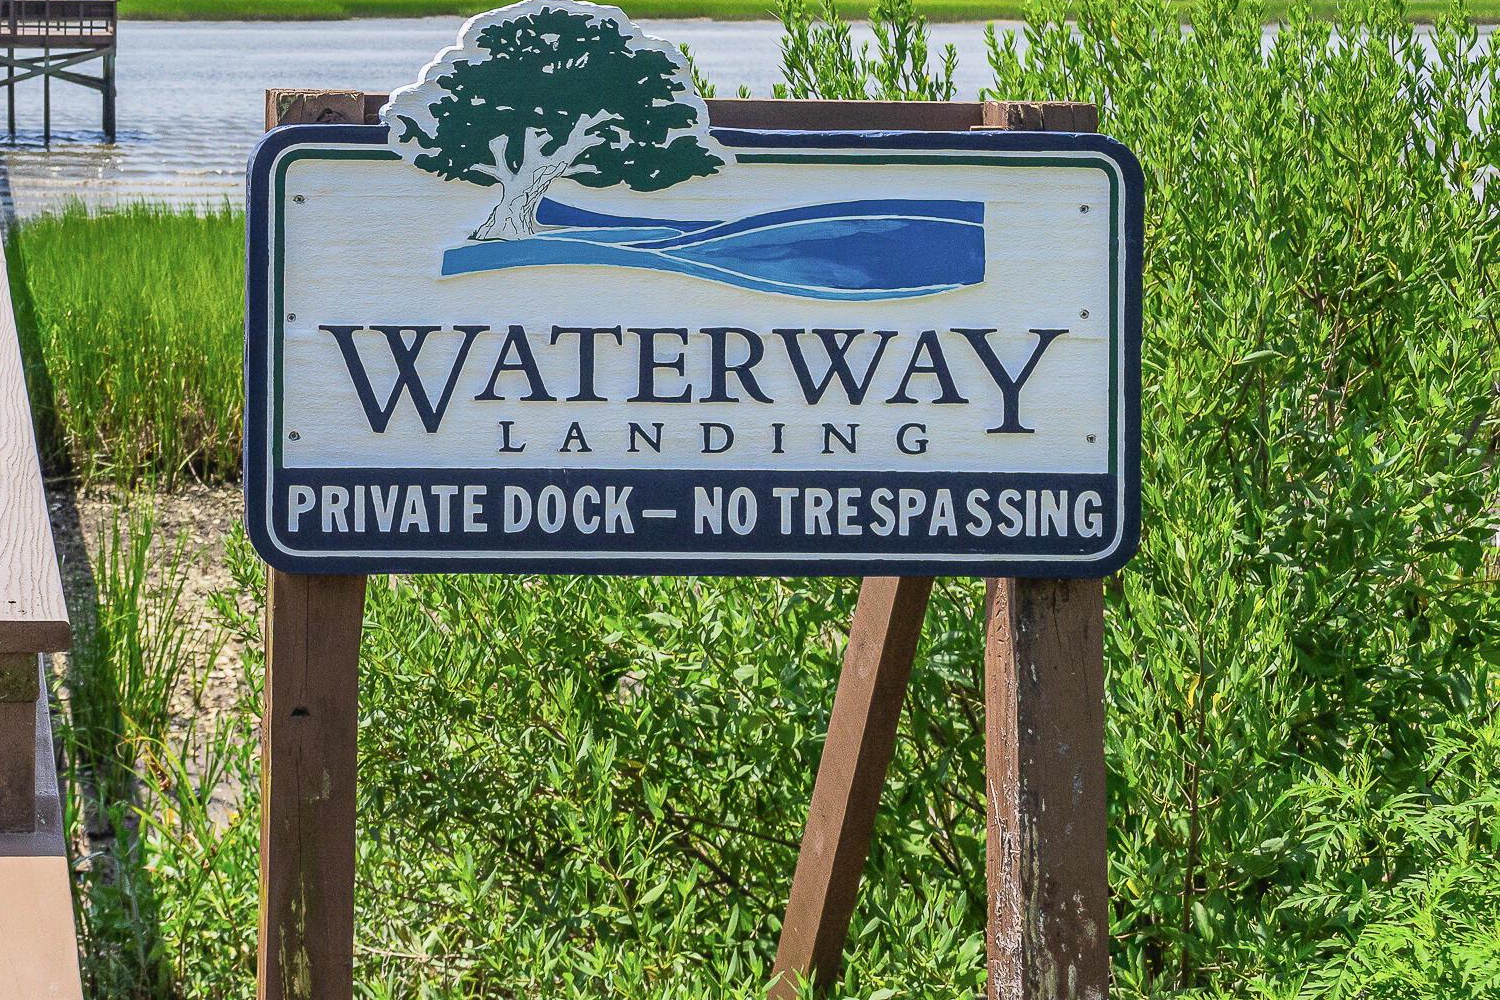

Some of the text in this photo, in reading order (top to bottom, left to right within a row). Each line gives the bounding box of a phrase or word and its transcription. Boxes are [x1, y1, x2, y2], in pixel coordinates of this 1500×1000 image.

[317, 324, 1070, 435] WATERWAY
[498, 420, 929, 456] LANDING
[287, 484, 489, 534] PRIVATE
[693, 486, 758, 536] NO
[772, 486, 1104, 539] TRESPASSING
